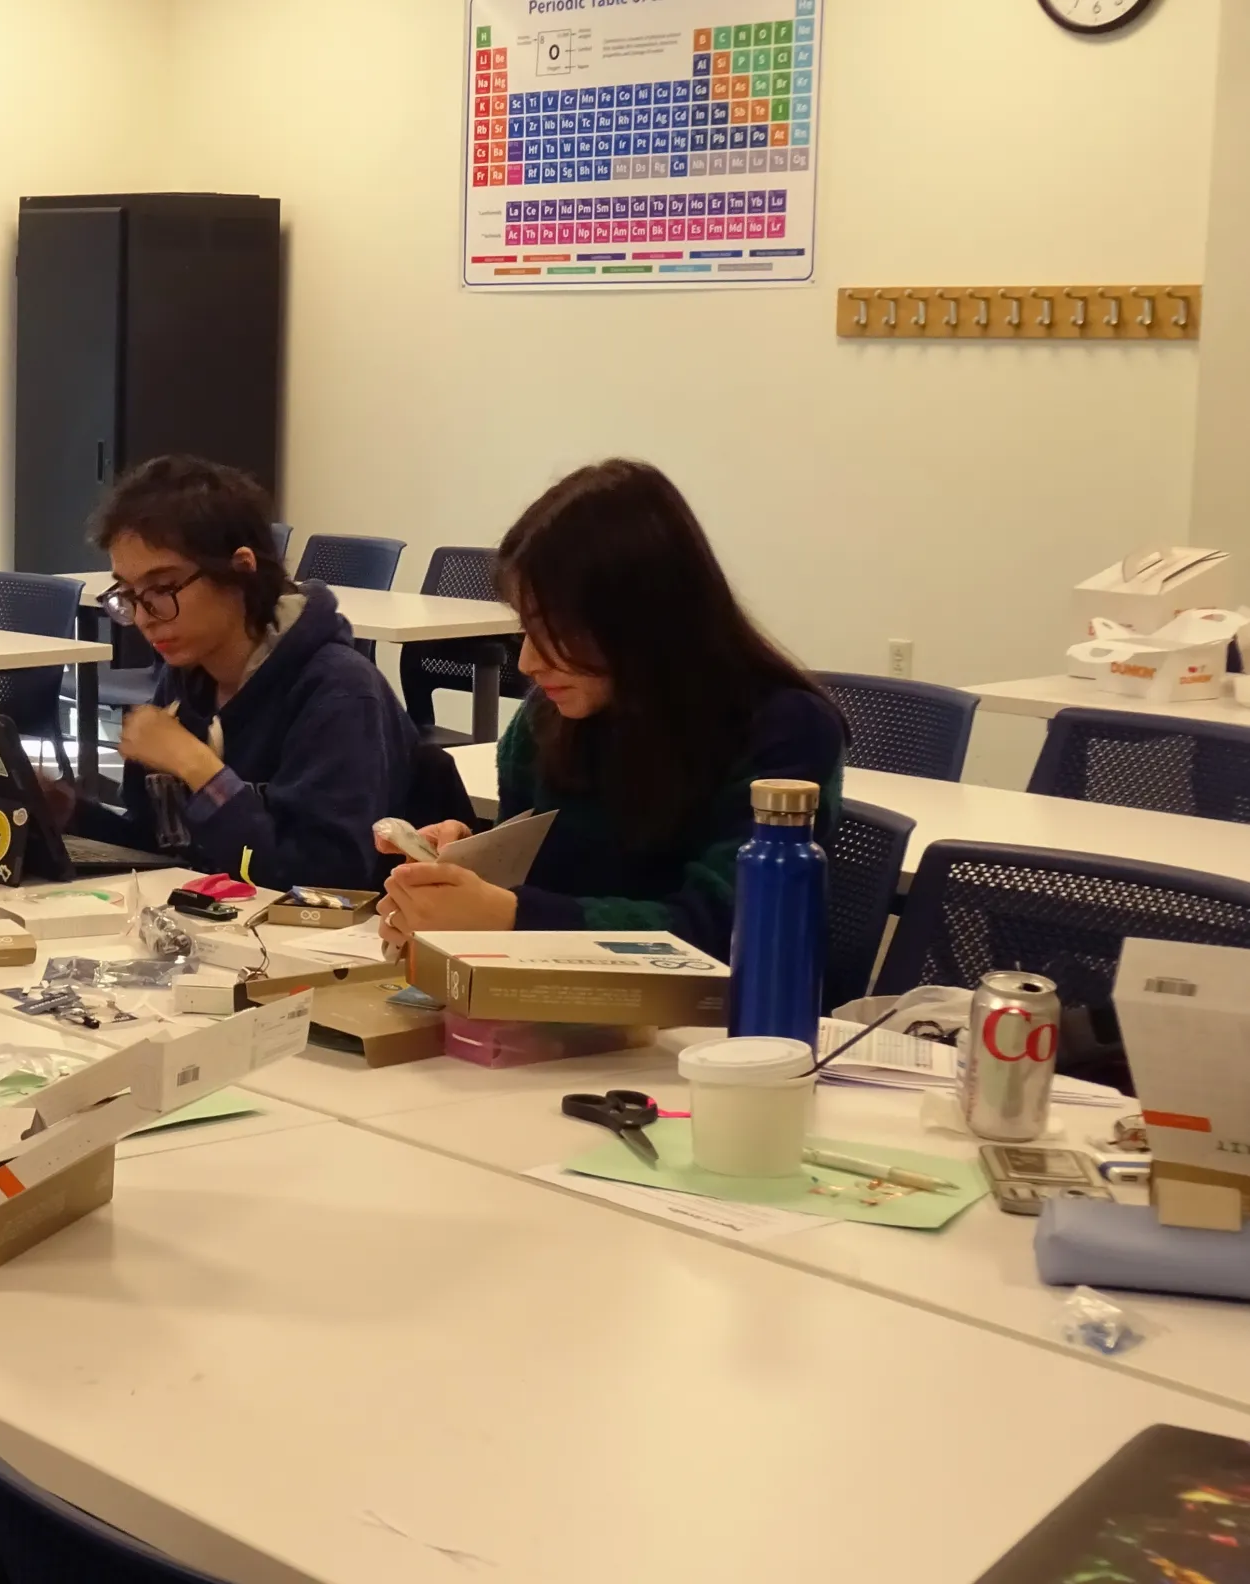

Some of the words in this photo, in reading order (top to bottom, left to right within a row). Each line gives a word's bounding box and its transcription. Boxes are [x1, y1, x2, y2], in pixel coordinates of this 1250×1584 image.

[529, 0, 585, 14] Periodic
[1093, 1, 1102, 14] 6
[717, 58, 726, 68] Si
[477, 79, 489, 88] Na
[494, 100, 505, 111] Ca
[512, 99, 521, 109] Sc
[529, 97, 537, 108] Ti
[564, 95, 575, 105] Cr
[581, 94, 594, 104] Mn
[601, 92, 611, 102] Fe
[618, 91, 631, 101] Co
[656, 87, 668, 98] Cu
[675, 86, 687, 97] Zn
[694, 84, 707, 95] Ga
[714, 83, 727, 94] Ge
[734, 82, 746, 92] As
[755, 80, 767, 91] Se
[776, 78, 788, 89] Br
[476, 124, 487, 135] Rb
[494, 124, 504, 134] Sr
[528, 121, 538, 132] Zr
[544, 120, 556, 130] Nb
[561, 119, 574, 129] Mo
[581, 117, 591, 128] Tc
[599, 116, 611, 127] Ru
[618, 115, 630, 125] Rh
[636, 113, 648, 124] Pd
[655, 112, 668, 125] Ag
[674, 110, 687, 121] Cd
[695, 110, 705, 120] In
[714, 108, 726, 119] Sn
[734, 107, 746, 117] Sb
[754, 105, 766, 116] Te
[528, 144, 538, 155] Hf
[545, 144, 555, 153] Ta
[579, 142, 591, 151] Re
[597, 140, 609, 151] Os
[619, 139, 627, 149] Ir
[636, 138, 647, 148] Pt
[654, 137, 667, 147] Au
[673, 136, 686, 148] Hg
[712, 133, 725, 144] Pb
[753, 131, 766, 141] Po
[476, 148, 486, 158] Cs
[493, 147, 504, 157] Ba
[476, 171, 485, 181] Fr
[492, 170, 503, 180] Ra
[527, 167, 538, 178] Rf
[544, 167, 556, 178] Db
[562, 166, 573, 179] Sg
[579, 165, 590, 176] Bh
[597, 165, 608, 175] Hs
[673, 160, 685, 171] Cn
[509, 207, 519, 217] La
[526, 206, 537, 216] Ce
[544, 205, 554, 215] Pr
[561, 204, 573, 214] Nd
[578, 204, 592, 214] Pm
[596, 203, 609, 213] Sm
[615, 202, 626, 213] Eu
[633, 201, 645, 212] Gd
[652, 200, 664, 211] Tb
[671, 200, 684, 212] Dy
[690, 199, 704, 209] Ho
[711, 198, 722, 209] Er
[729, 198, 744, 208] Tm
[750, 196, 763, 207] Yb
[771, 196, 783, 206] Lu
[508, 230, 518, 240] Ac
[525, 229, 536, 239] Th
[543, 229, 554, 239] Pa
[578, 228, 590, 239] Np
[596, 227, 608, 237] Pu
[613, 227, 627, 236] Am
[632, 226, 646, 236] Cm
[652, 225, 663, 236] Bk
[672, 224, 682, 235] Cf
[691, 224, 702, 234] Es
[709, 223, 723, 233] Fm
[728, 222, 743, 233] Md
[771, 221, 782, 232] Lr
[982, 1007, 1058, 1062] Co
[1217, 1140, 1250, 1155] IT
